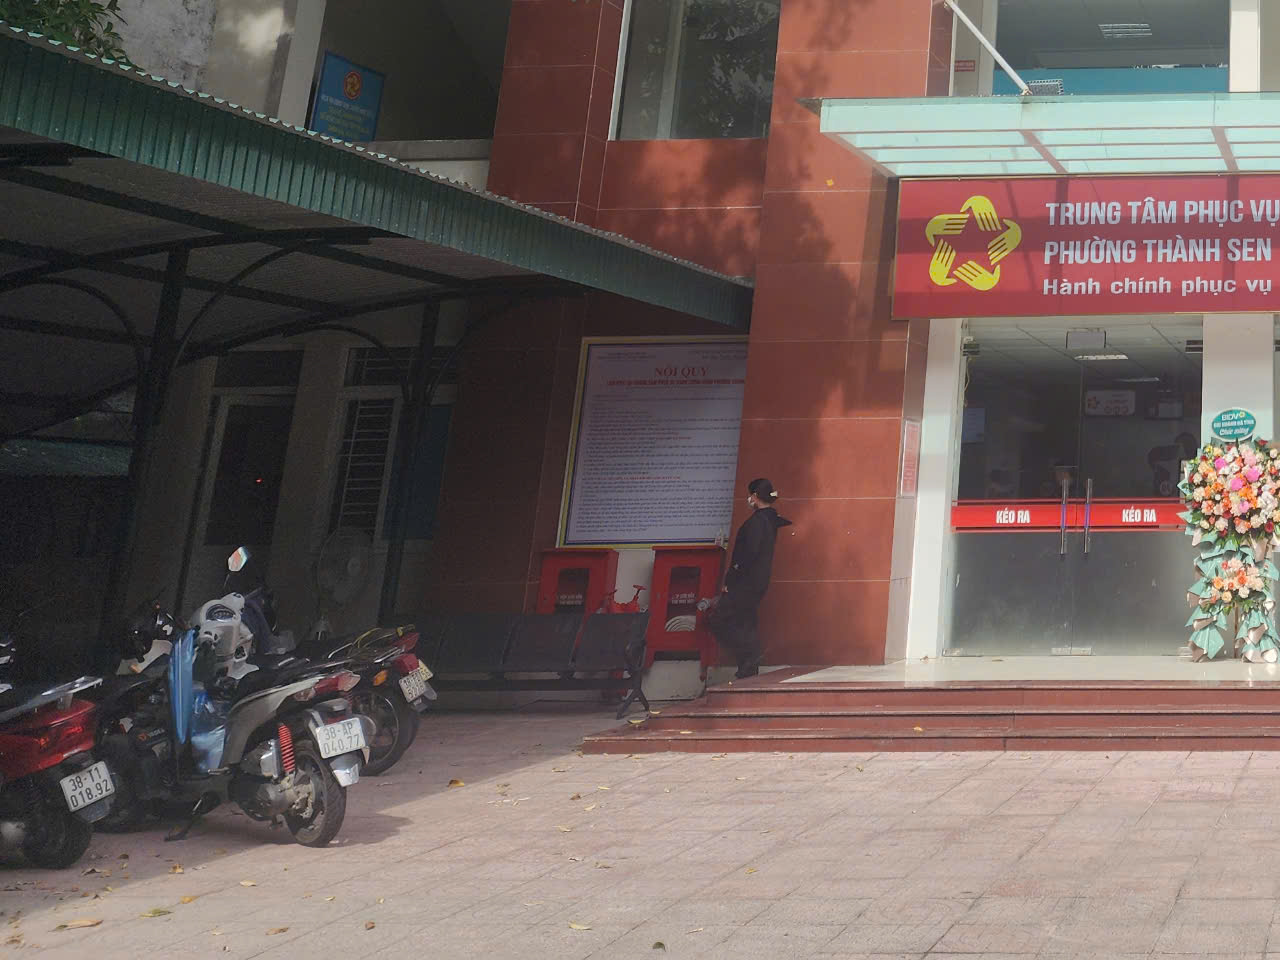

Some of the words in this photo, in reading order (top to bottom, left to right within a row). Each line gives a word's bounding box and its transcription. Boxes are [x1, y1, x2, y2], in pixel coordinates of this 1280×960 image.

[1046, 201, 1121, 226] TRUNG
[1128, 196, 1177, 224] TÂM
[1184, 200, 1244, 228] PHỤC
[1250, 199, 1280, 227] VỤ
[1044, 235, 1137, 265] PHƯỜNG
[1143, 234, 1220, 263] THÀNH
[1227, 237, 1272, 262] SEN
[1043, 277, 1100, 295] Hành
[1110, 277, 1171, 295] chính
[1182, 276, 1237, 297] phục
[1246, 279, 1272, 296] vụ
[1222, 413, 1239, 421] BIDV
[996, 506, 1014, 524] KÉO
[1017, 509, 1030, 523] RA
[1122, 506, 1141, 522] KÉO
[1143, 509, 1157, 522] RA
[323, 721, 353, 740] 38-AP
[323, 734, 360, 755] 040.77
[69, 767, 101, 791] 38-T1
[70, 779, 111, 807] 018.92
